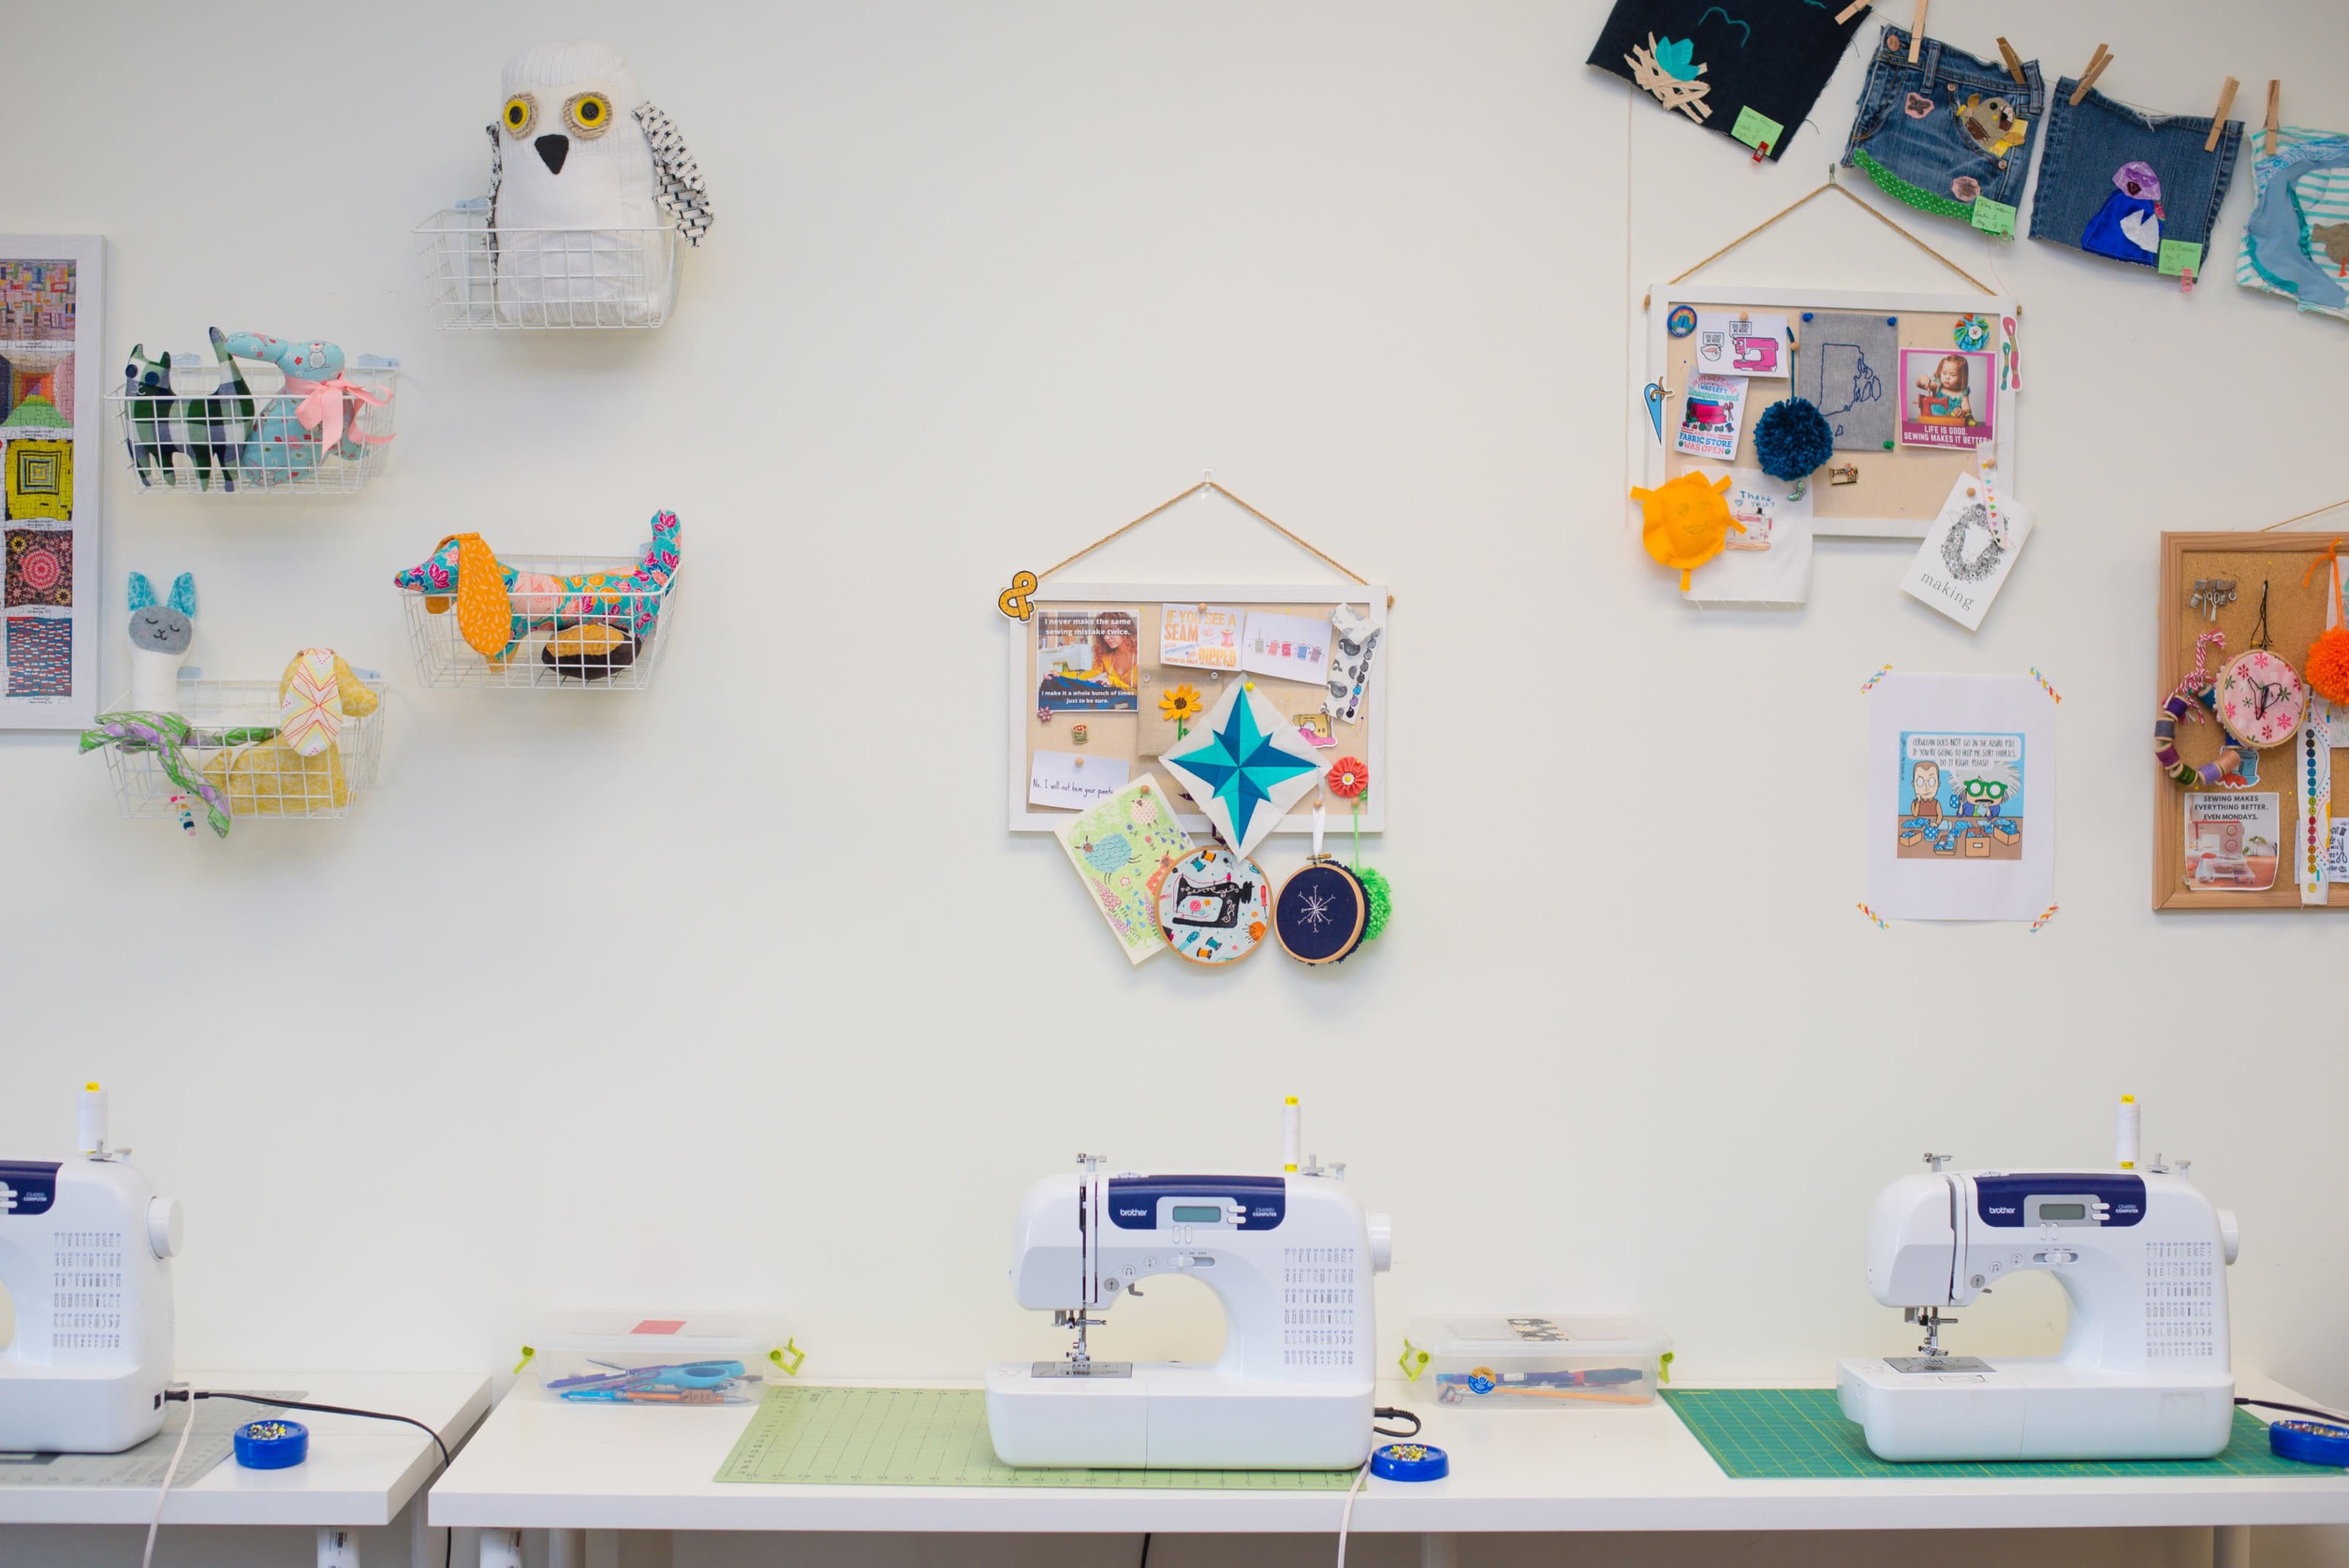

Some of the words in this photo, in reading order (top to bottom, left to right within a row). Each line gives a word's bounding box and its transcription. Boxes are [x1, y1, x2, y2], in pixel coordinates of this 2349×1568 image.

[1679, 432, 1704, 444] FABRIC
[1705, 438, 1732, 448] STORE
[1904, 432, 1928, 440] SEWING
[1931, 434, 1953, 443] MAKES
[1684, 441, 1700, 451] WAS
[1702, 445, 1724, 455] OPEN
[1921, 573, 1974, 611] making
[1167, 610, 1176, 622] IF
[1204, 612, 1225, 625] SEE
[1228, 614, 1236, 626] A
[1165, 623, 1198, 642] SEAM
[1045, 779, 1048, 788] I
[1051, 781, 1059, 789] will
[1072, 781, 1083, 792] hem
[1083, 788, 1096, 798] your
